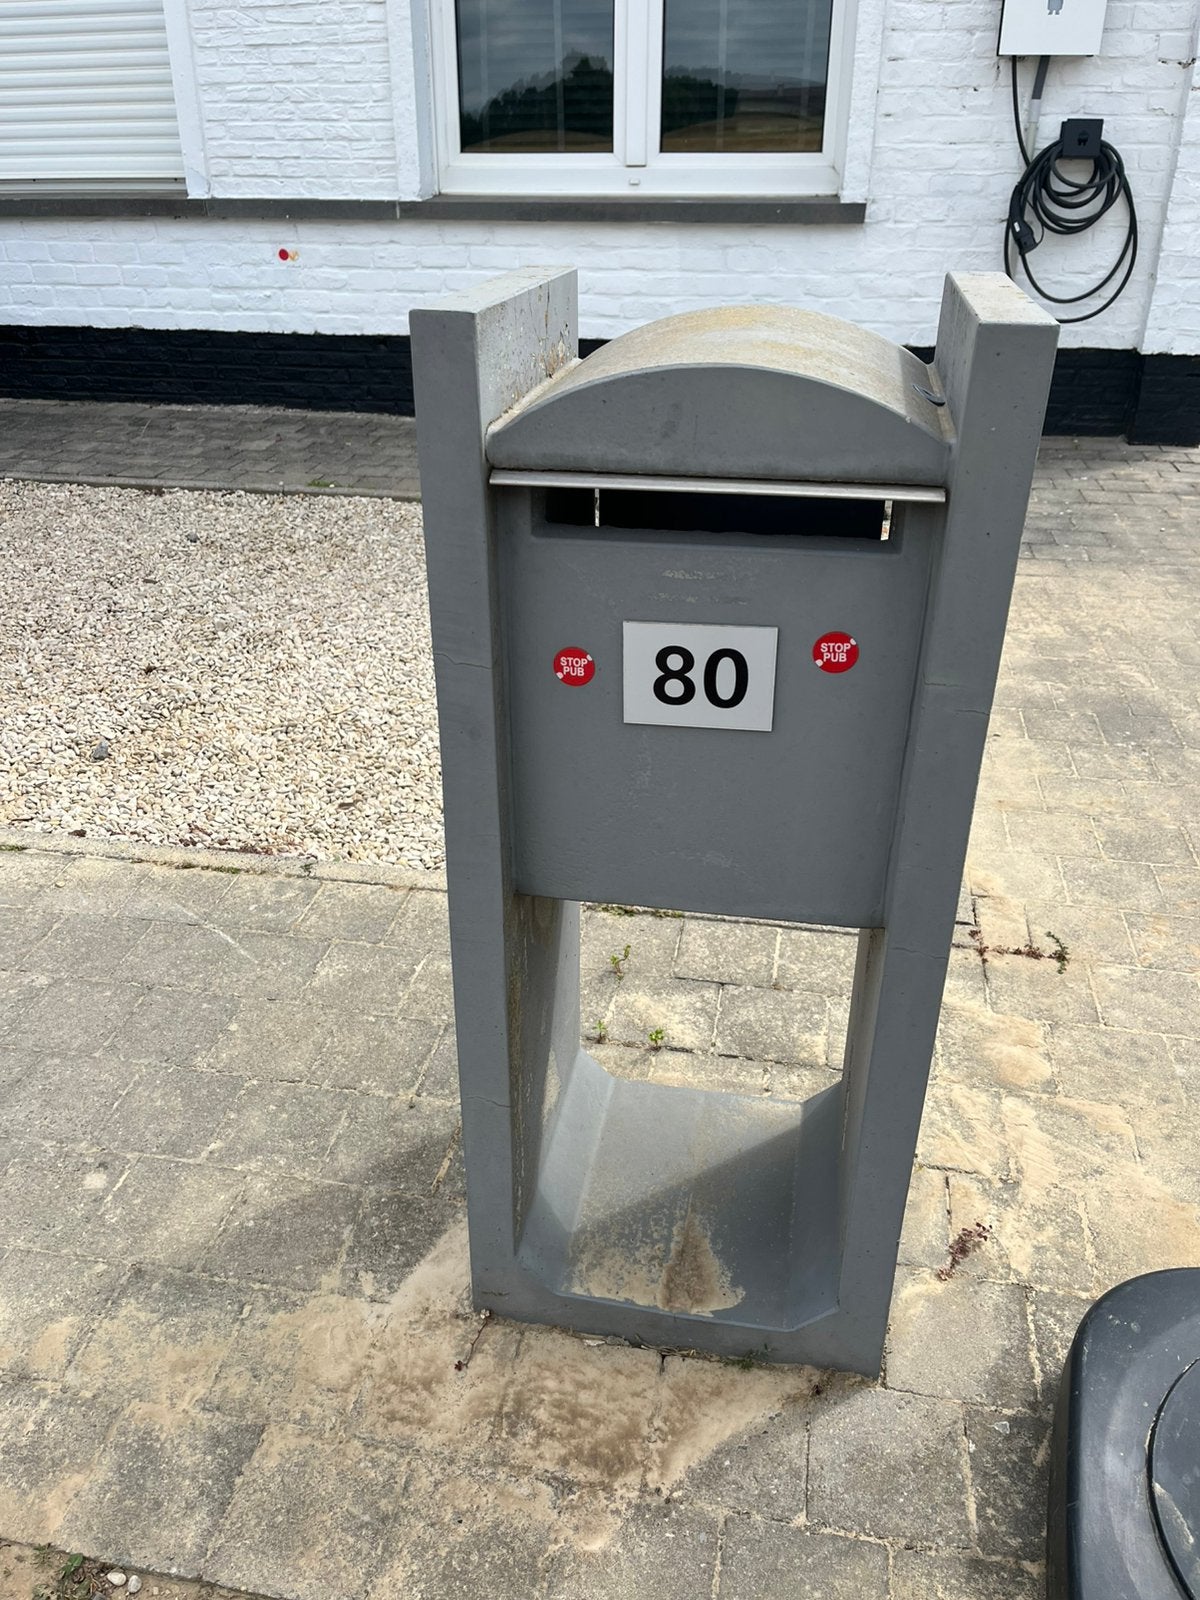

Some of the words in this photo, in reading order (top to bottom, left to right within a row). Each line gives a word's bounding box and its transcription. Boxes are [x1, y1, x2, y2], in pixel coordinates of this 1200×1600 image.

[820, 642, 851, 653] STOP
[560, 656, 588, 667] STOP
[823, 652, 847, 662] PUB
[563, 666, 585, 677] PUB
[653, 645, 749, 709] 80
